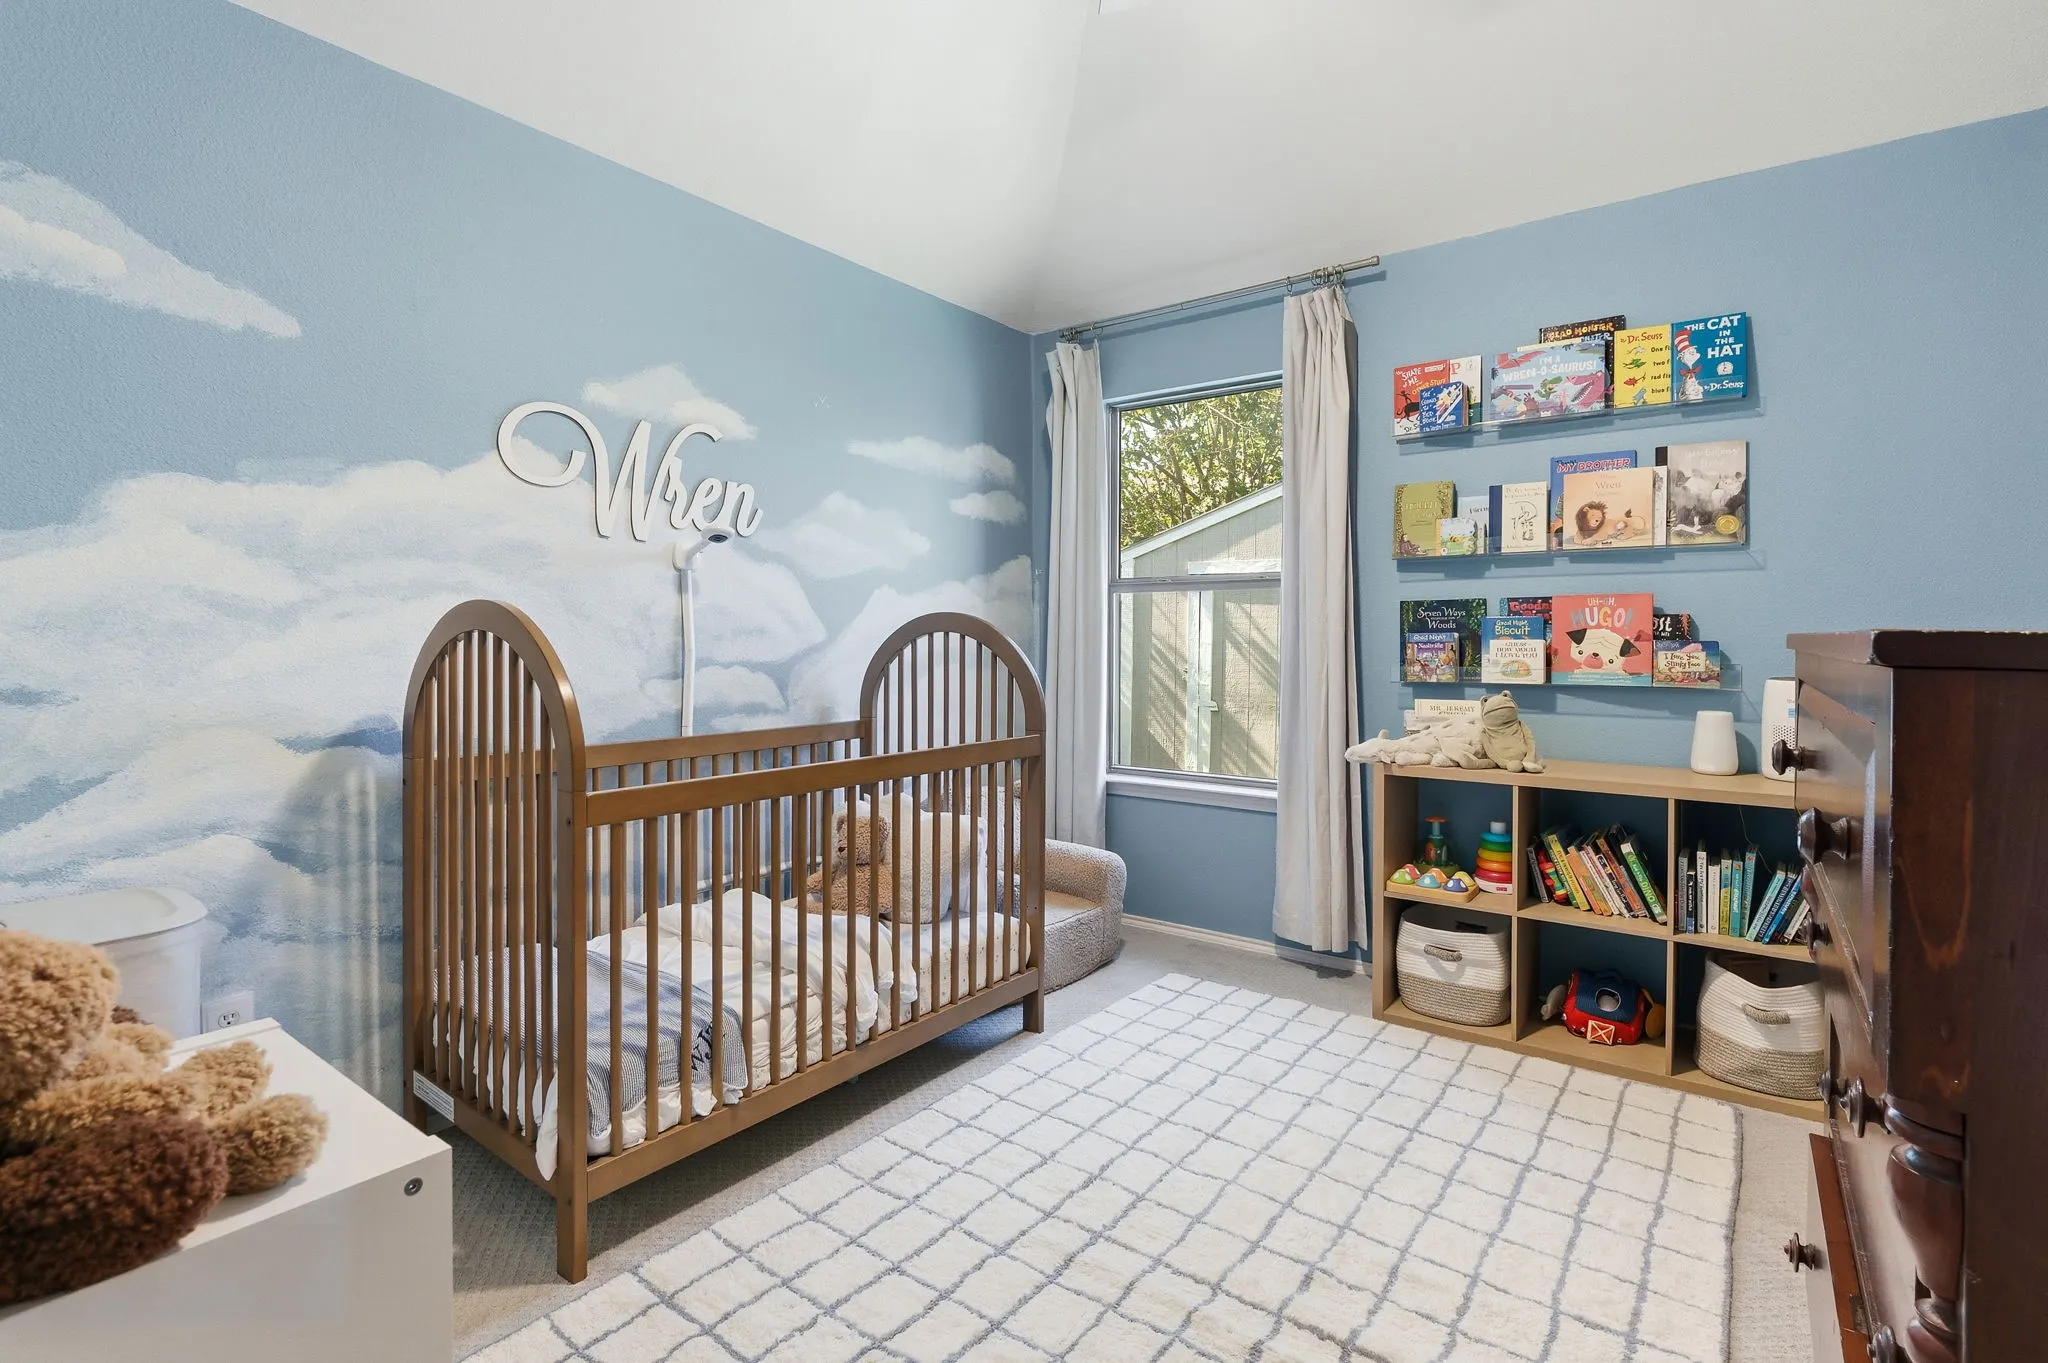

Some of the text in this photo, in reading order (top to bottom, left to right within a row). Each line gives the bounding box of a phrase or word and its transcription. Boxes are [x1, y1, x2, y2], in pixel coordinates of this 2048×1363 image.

[1574, 321, 1614, 336] MONSTER
[1684, 314, 1741, 331] THE CAT
[1627, 334, 1641, 345] Dr.
[1641, 331, 1663, 342] Seuss
[1718, 329, 1730, 337] IN
[1714, 337, 1735, 345] THE
[1707, 343, 1743, 359] HAT
[1539, 354, 1561, 365] I'M A
[1401, 366, 1422, 381] SHAPE
[1502, 360, 1597, 382] WREN-O-SAURUS!
[1406, 375, 1420, 387] ME
[1709, 382, 1723, 392] Dr.
[1723, 379, 1744, 389] Seuss
[1651, 386, 1664, 394] blue
[497, 401, 763, 543] Wren
[1556, 463, 1576, 474] MY
[1577, 457, 1631, 472] BROTHER
[1595, 481, 1621, 490] Wren
[1416, 606, 1467, 620] Seven Ways
[1570, 606, 1634, 629] HUGO!
[1426, 617, 1457, 629] Woods
[1494, 625, 1531, 635] Biscuit
[1670, 653, 1683, 661] Love
[1664, 660, 1701, 669] Stinky Face
[1640, 880, 1656, 903] DINO
